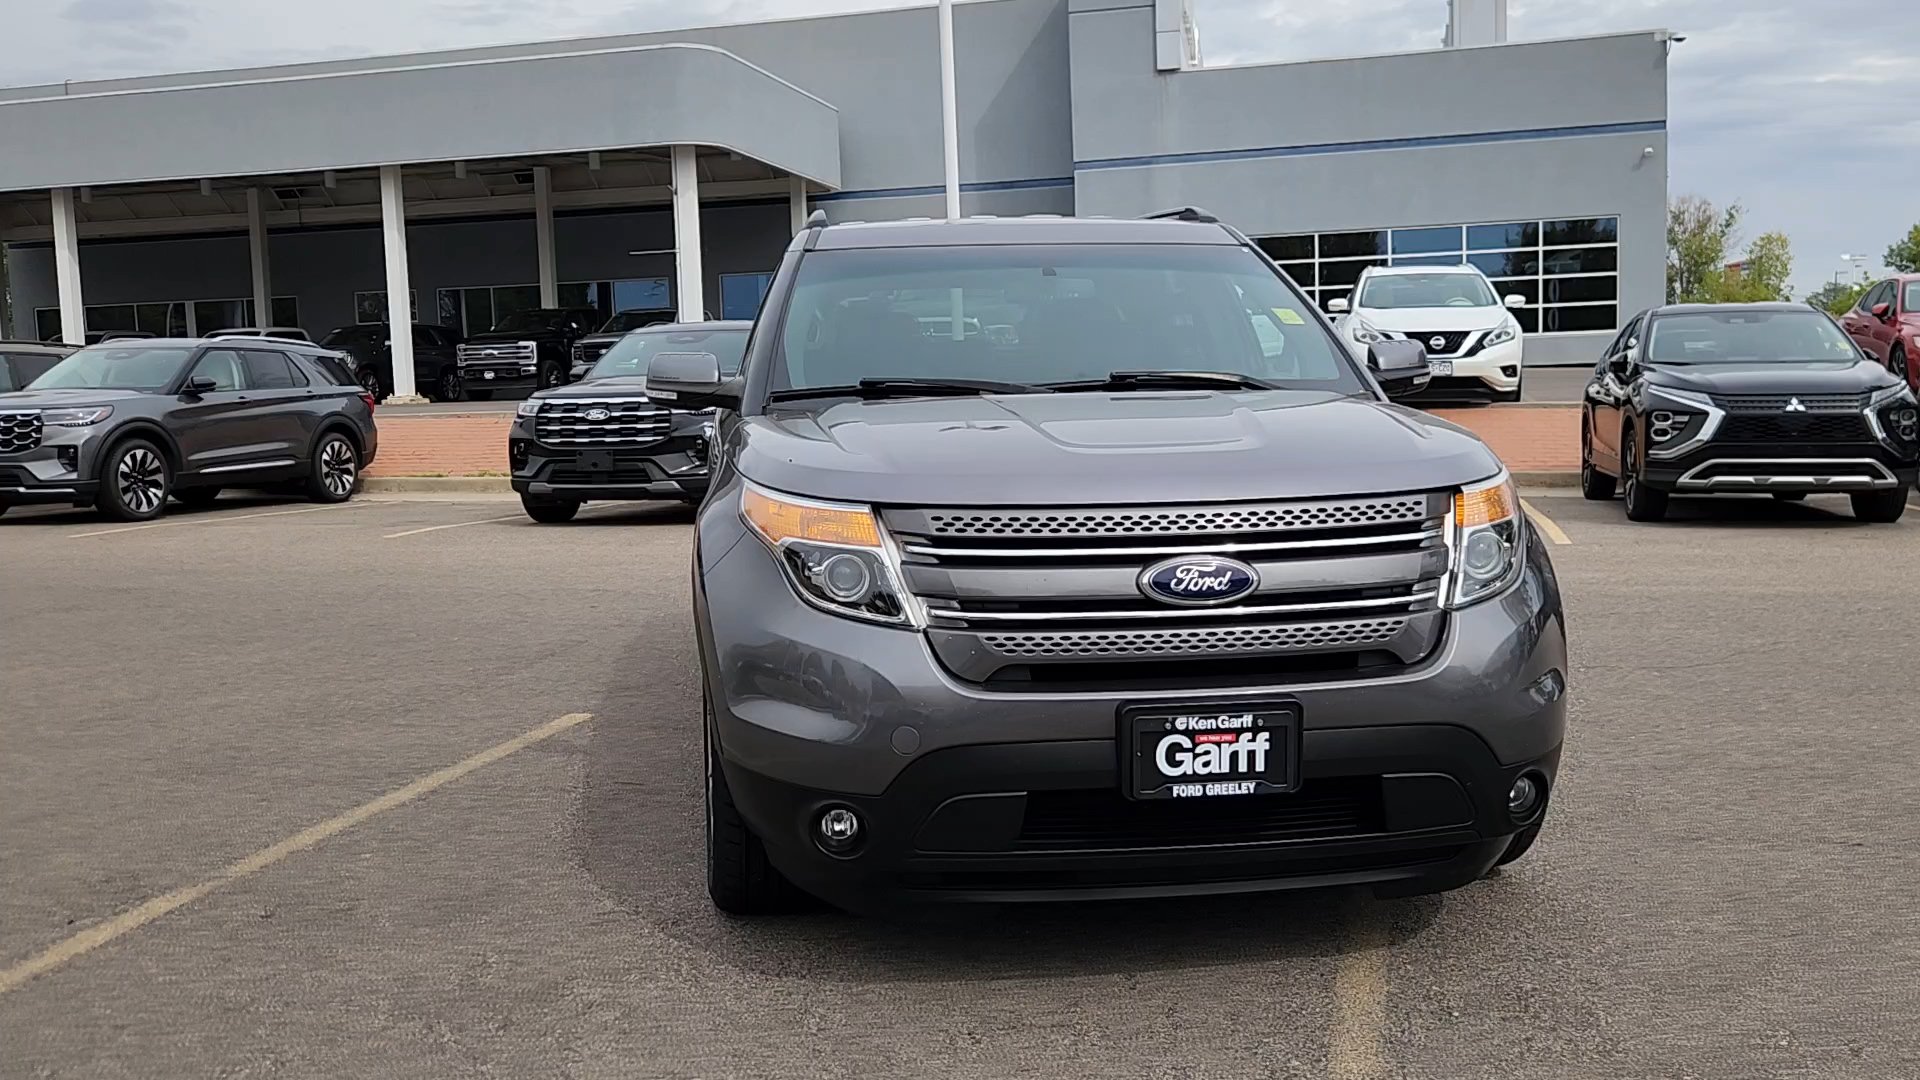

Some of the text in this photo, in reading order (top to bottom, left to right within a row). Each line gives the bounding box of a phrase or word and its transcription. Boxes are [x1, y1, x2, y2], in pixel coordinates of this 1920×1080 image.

[1170, 565, 1232, 593] Ford
[1188, 716, 1217, 730] Ken
[1217, 714, 1253, 729] Garff
[1155, 731, 1270, 777] Garff
[1172, 781, 1256, 798] FORD GREELEY
